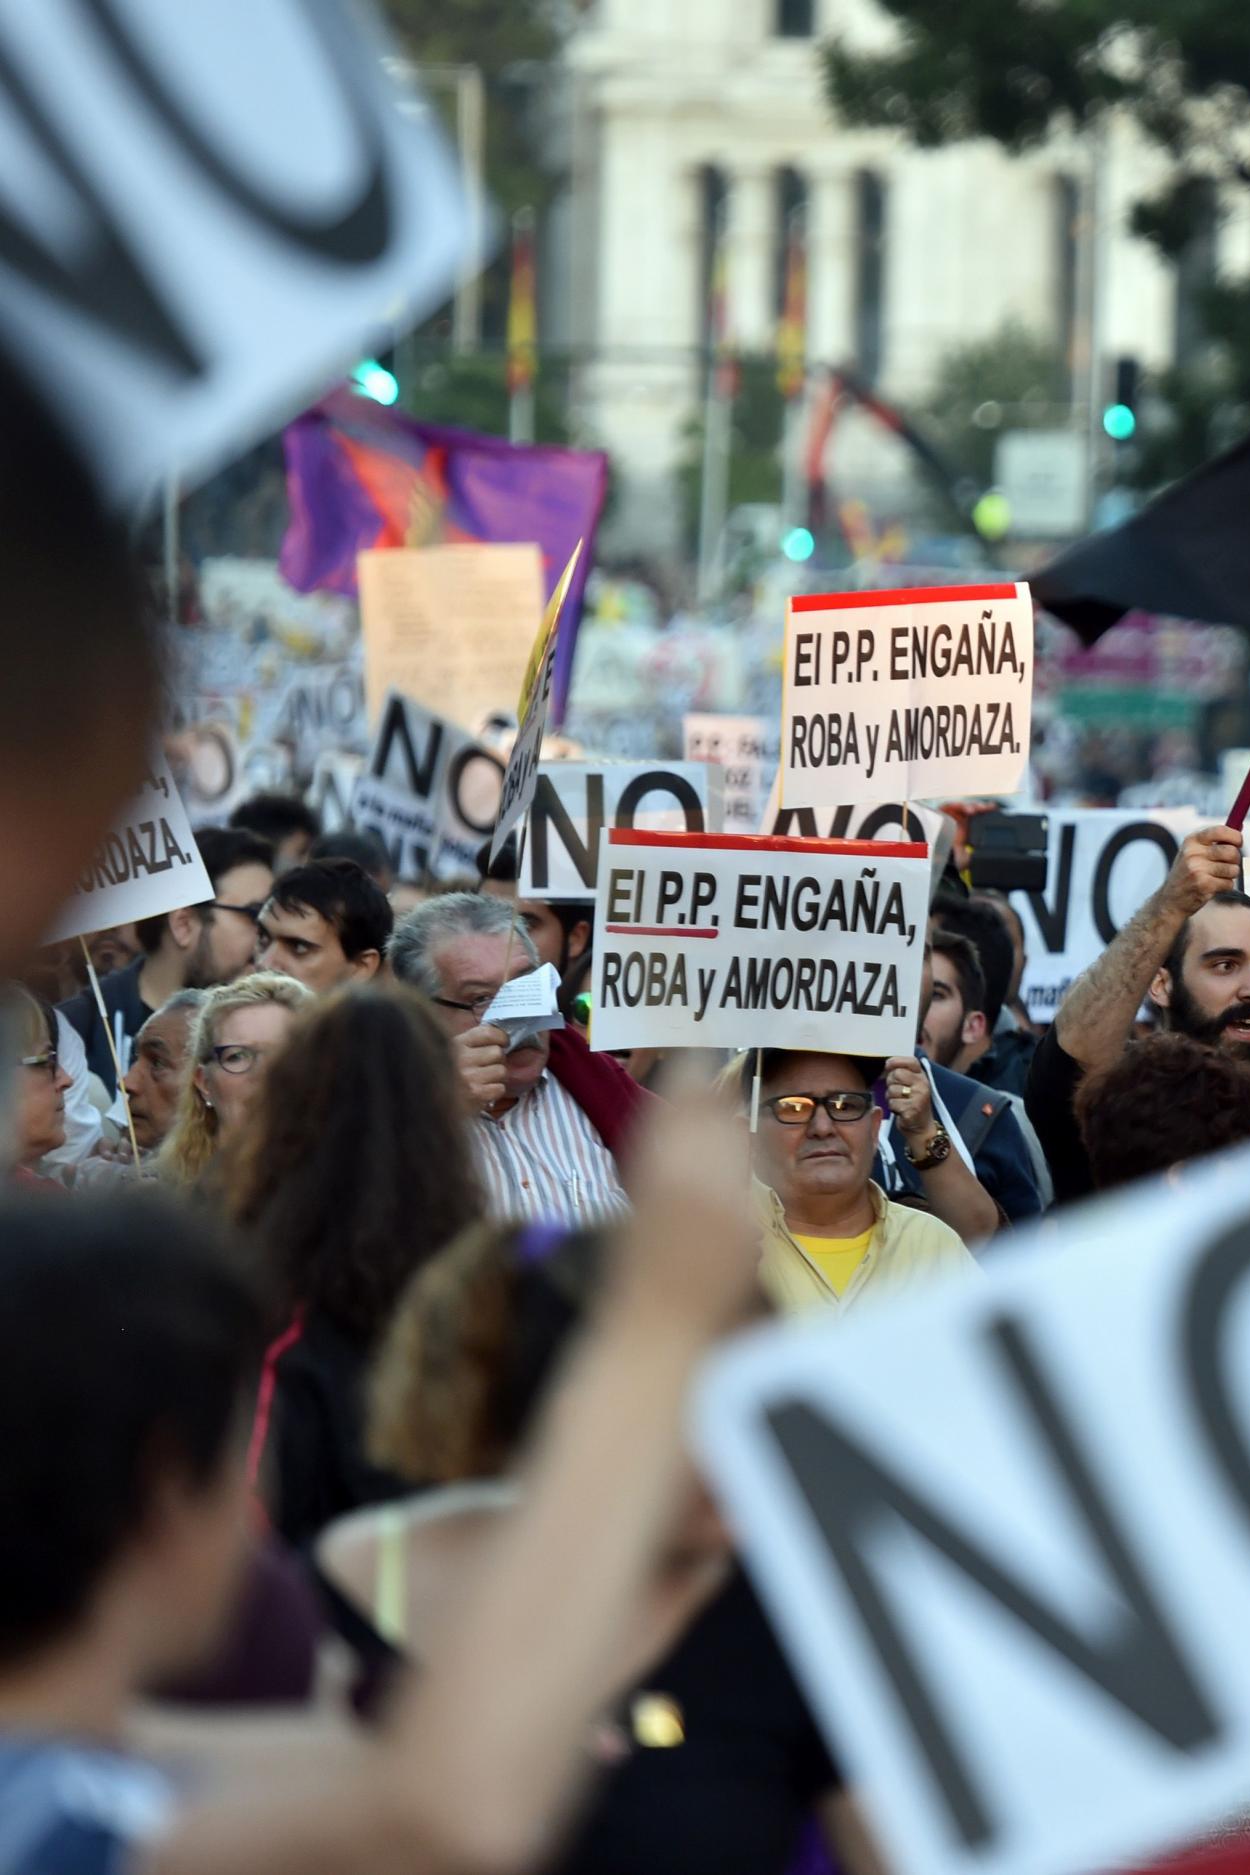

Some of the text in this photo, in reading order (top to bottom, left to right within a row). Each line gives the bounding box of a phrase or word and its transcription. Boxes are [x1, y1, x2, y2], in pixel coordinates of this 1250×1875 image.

[793, 609, 1026, 687] El P.P. ENGAÑA,
[372, 693, 504, 836] NO
[790, 710, 860, 769] ROBA
[865, 723, 880, 779] y
[884, 701, 1021, 763] AMORDAZA.
[606, 867, 917, 947] El P.P. ENGAÑA,
[600, 951, 689, 1009] ROBA
[692, 965, 718, 1022] y
[719, 956, 908, 1018] AMORDAZA.
